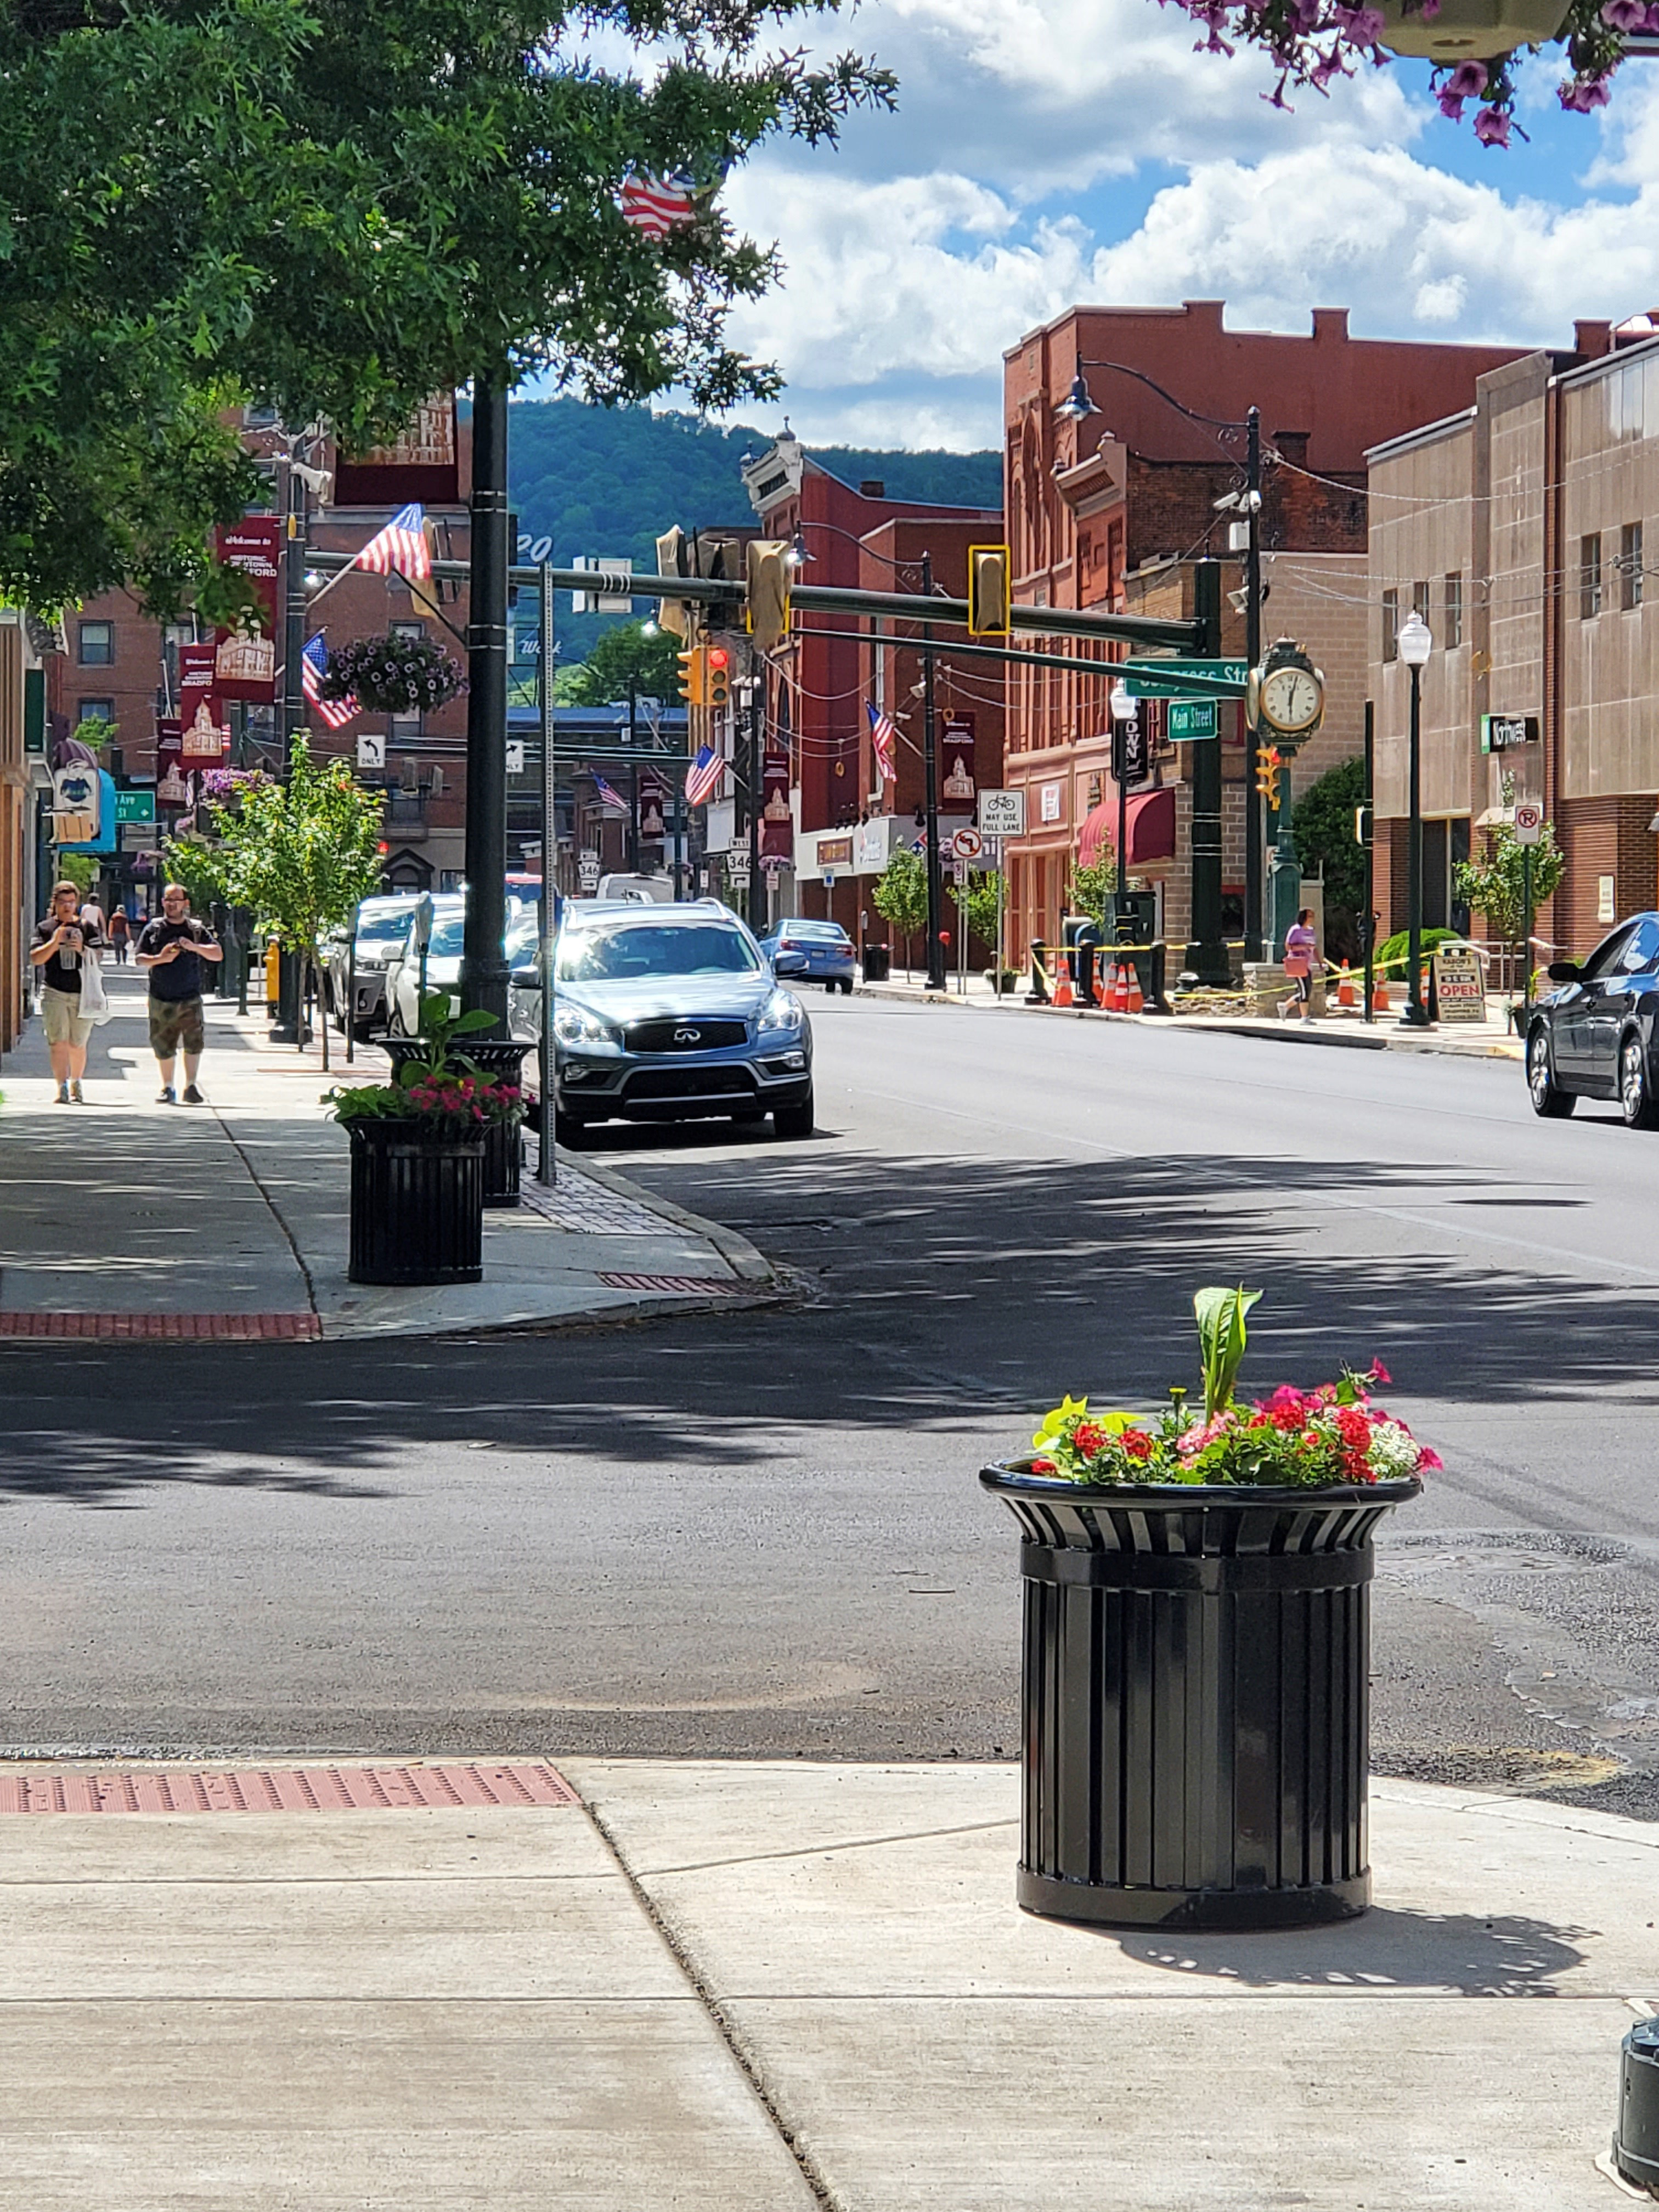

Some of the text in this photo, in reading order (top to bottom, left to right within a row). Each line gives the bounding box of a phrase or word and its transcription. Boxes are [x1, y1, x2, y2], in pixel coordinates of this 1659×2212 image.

[518, 640, 562, 653] Wok
[1224, 666, 1248, 685] Str
[1172, 705, 1212, 729] Main Street
[119, 794, 136, 805] Ave
[1003, 813, 1018, 821] USE
[983, 823, 999, 832] FULL
[730, 856, 752, 868] 346
[580, 866, 598, 876] 346
[1440, 985, 1480, 996] OPEN
